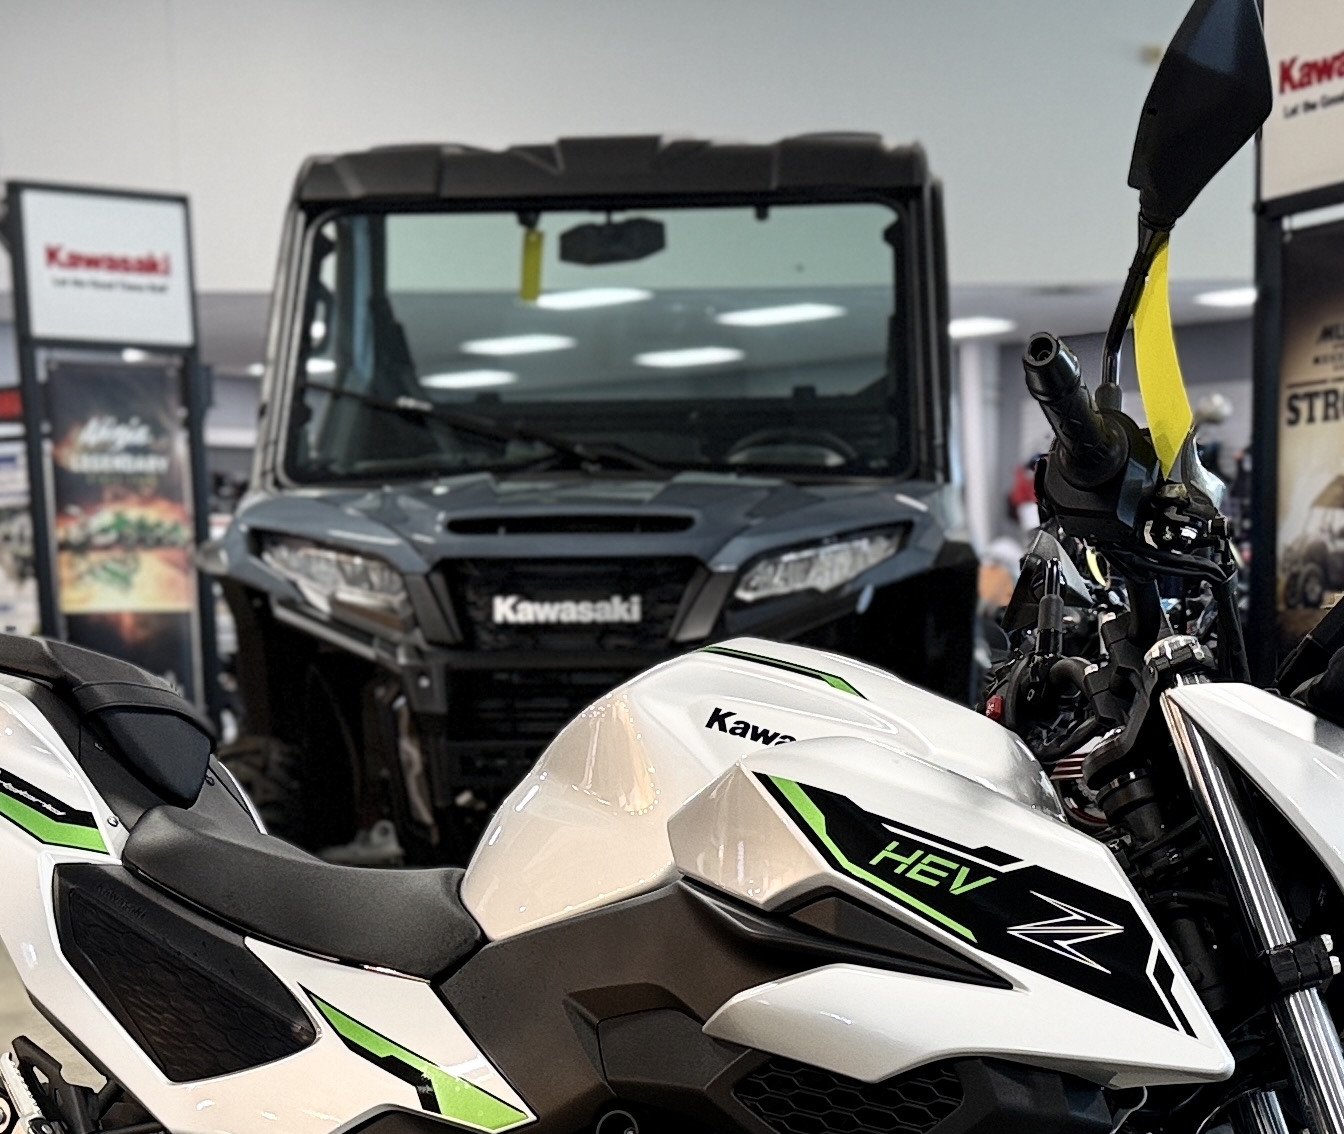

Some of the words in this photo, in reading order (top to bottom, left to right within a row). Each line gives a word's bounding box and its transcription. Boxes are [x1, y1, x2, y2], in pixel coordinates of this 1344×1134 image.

[44, 243, 171, 277] Kawasaki
[492, 595, 642, 625] Kawasaki
[869, 841, 997, 896] HEV
